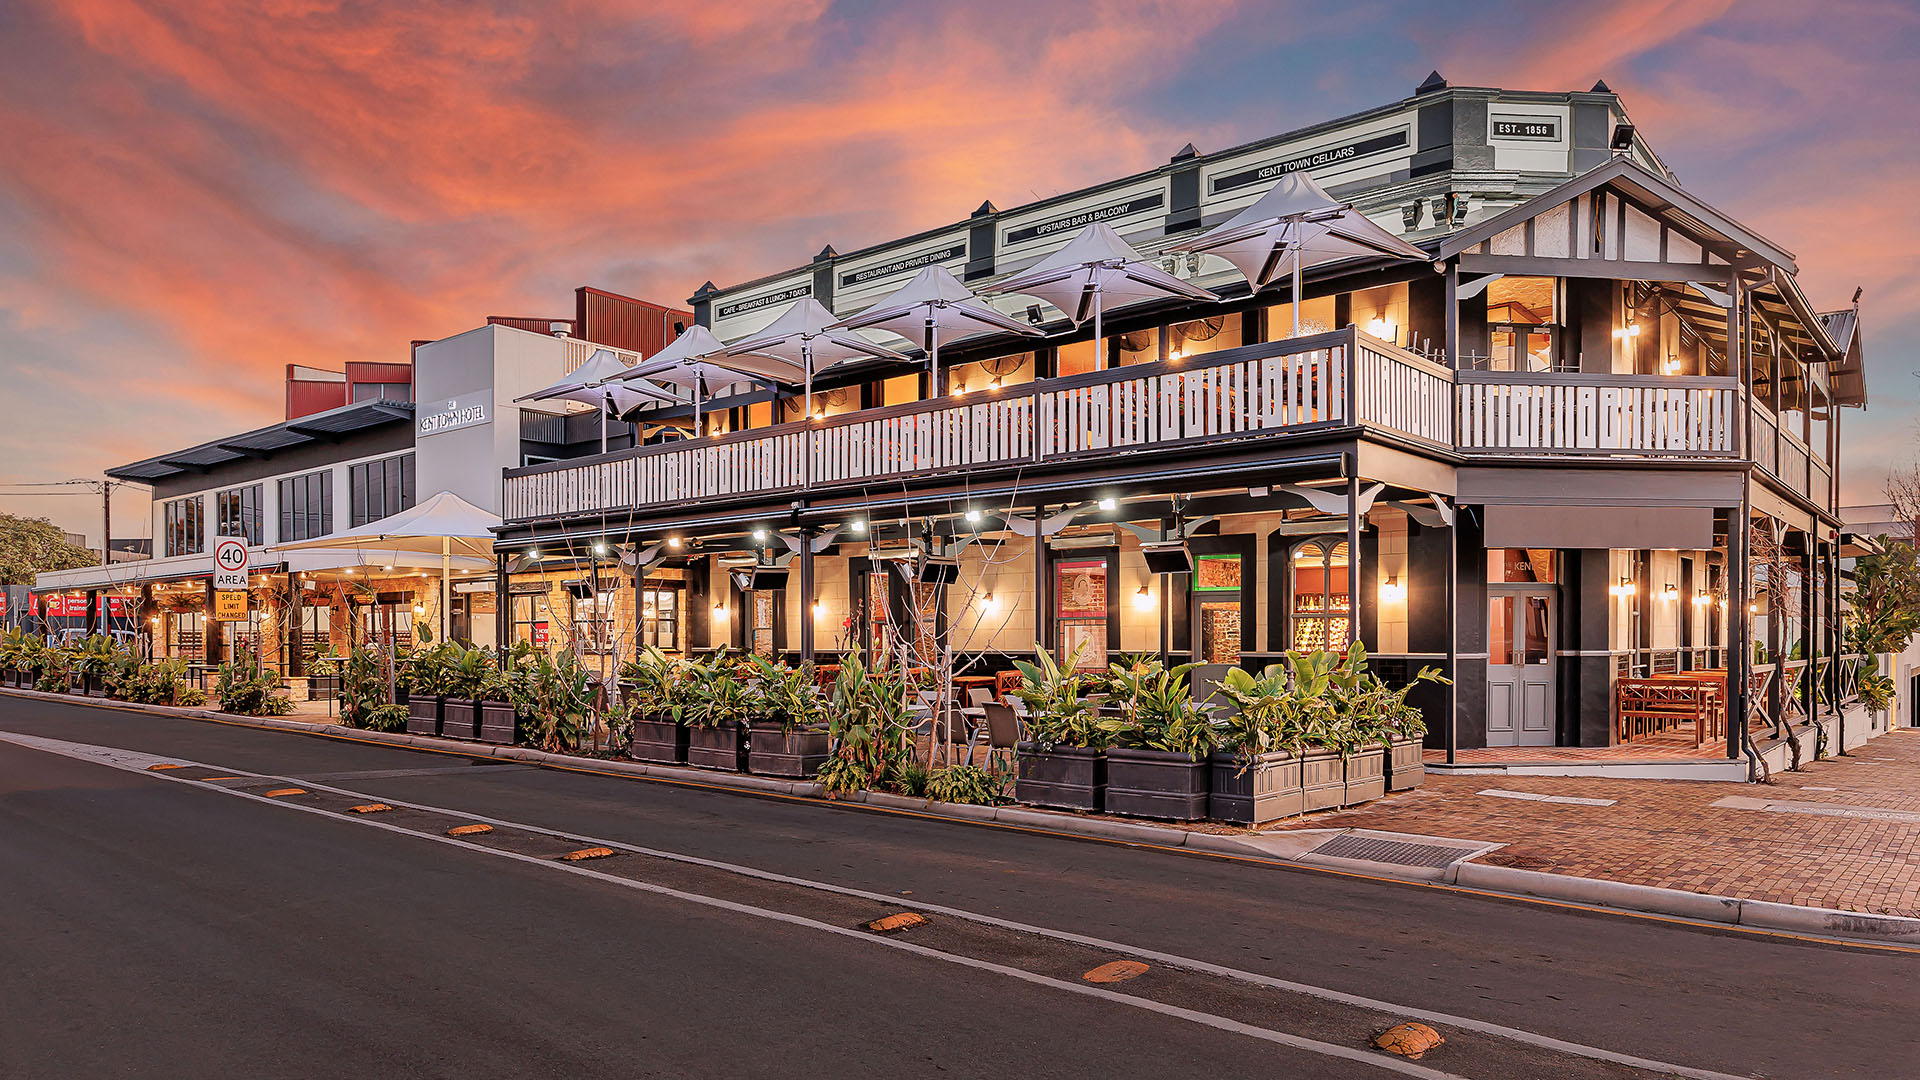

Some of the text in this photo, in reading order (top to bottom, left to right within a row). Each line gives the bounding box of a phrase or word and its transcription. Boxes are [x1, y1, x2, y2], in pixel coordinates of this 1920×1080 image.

[1499, 124, 1547, 134] EST. 1856
[1258, 146, 1354, 178] KENT TOWN CELLARS
[1036, 204, 1130, 234] UPSTAIRS BAR & BALCONY
[856, 250, 951, 281] RESTAURANT AND PRIVATE DINING
[738, 298, 765, 311] BREAKFAST
[770, 292, 786, 303] LUNCH
[793, 288, 806, 297] DAYS
[461, 405, 485, 424] HOTEL
[221, 549, 242, 563] 40
[1514, 562, 1534, 570] KEN
[218, 575, 246, 584] AREA
